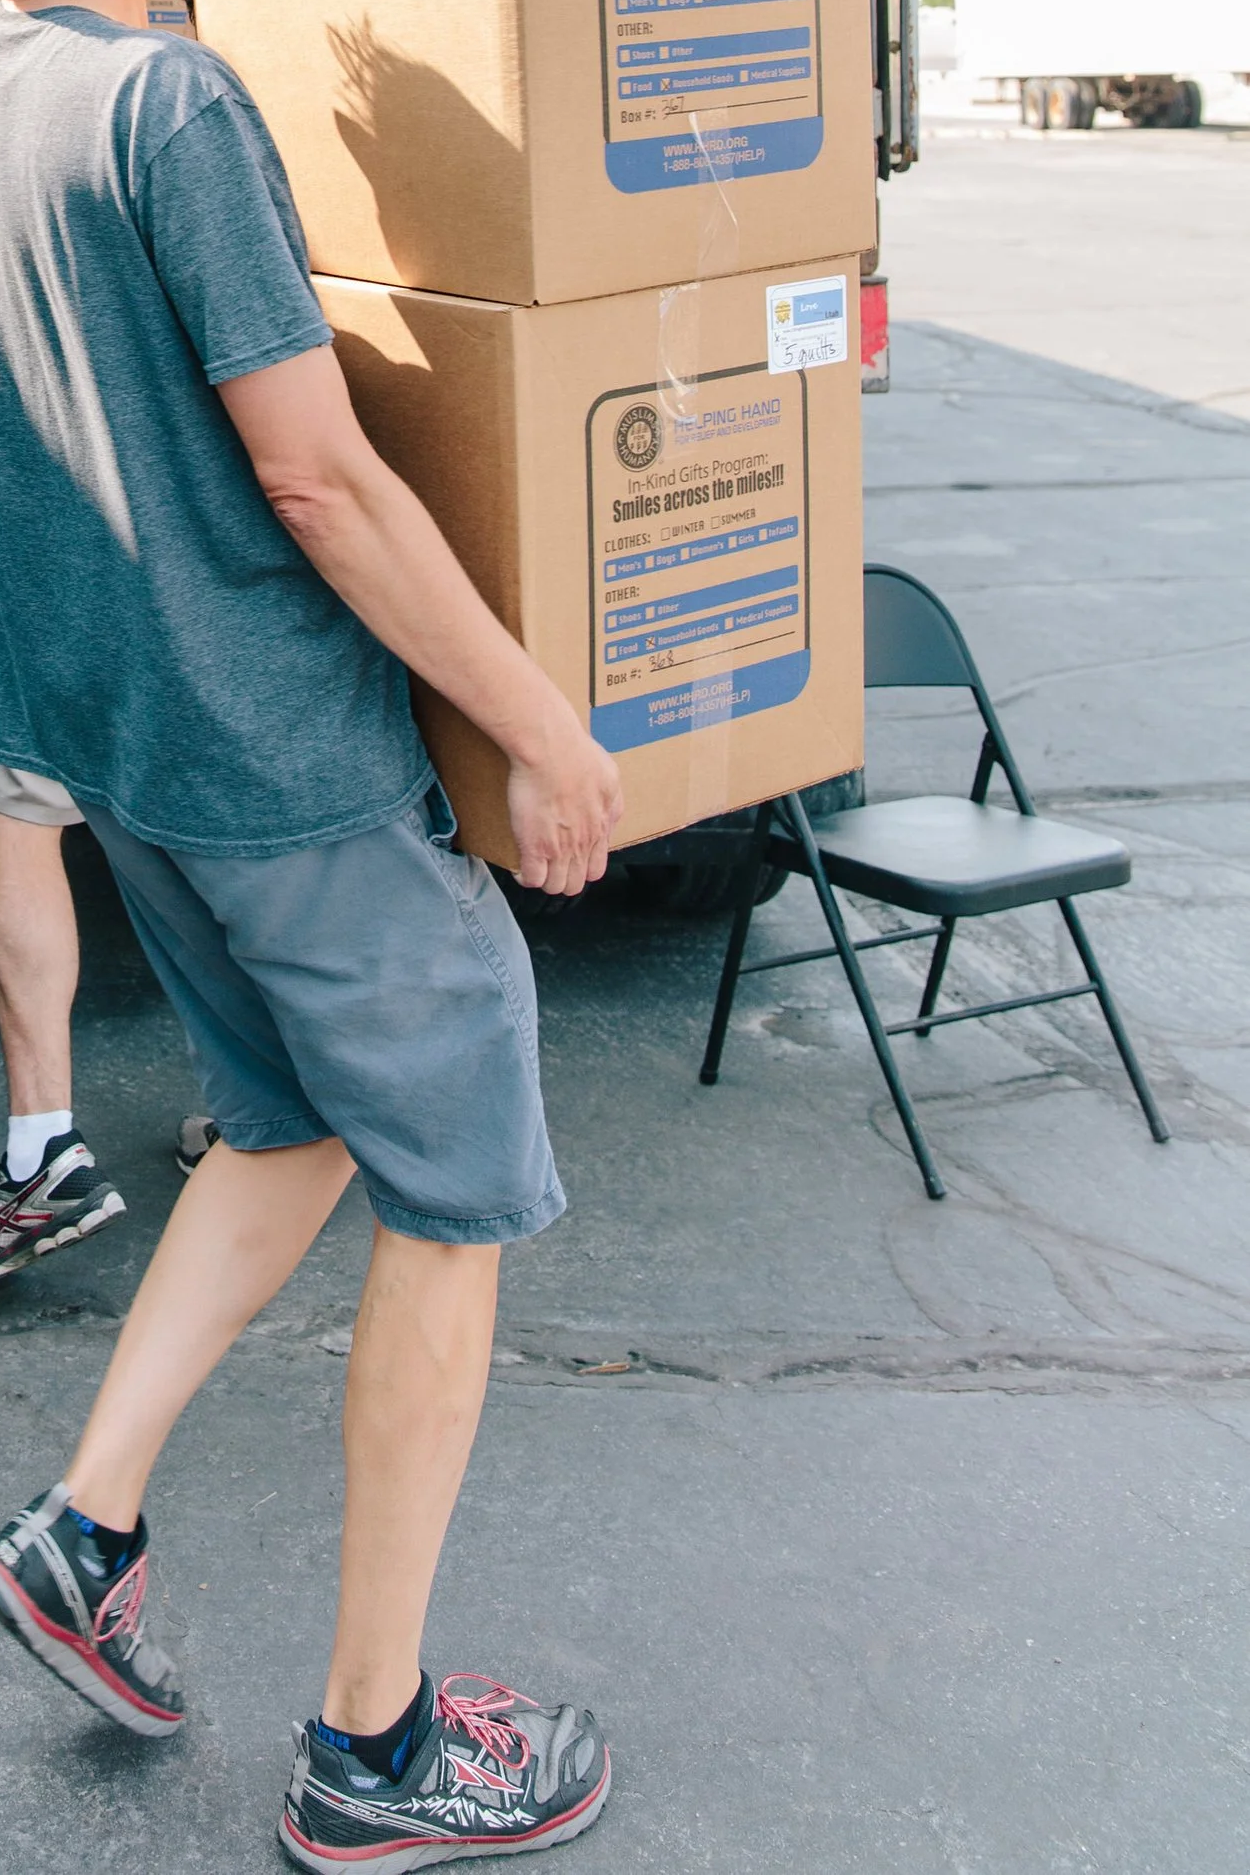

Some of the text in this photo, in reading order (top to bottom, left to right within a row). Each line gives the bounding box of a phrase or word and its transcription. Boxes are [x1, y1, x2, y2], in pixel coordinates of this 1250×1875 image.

[617, 22, 654, 37] OTHER:
[632, 82, 653, 92] Food
[620, 110, 642, 123] Box
[799, 302, 819, 313] Love
[783, 343, 797, 365] 5
[674, 398, 781, 433] HELPING HAND
[716, 426, 732, 437] AND
[733, 415, 781, 434] DEVELOPMENT
[618, 442, 661, 467] HUMANITY
[628, 453, 769, 494] In-Kind Gifts Program:
[613, 464, 784, 523] Smiles across the miles!!!
[604, 508, 756, 553] CLOTHES: WINTER SUMMER
[618, 562, 642, 574] Men's
[656, 553, 677, 566] Boys
[769, 524, 794, 538] Infants
[605, 586, 640, 604] OTHER:
[619, 613, 642, 624] Shoes
[619, 643, 639, 656] Food
[736, 610, 763, 625] Medical
[764, 603, 793, 618] Supplies
[606, 673, 628, 687] Box
[648, 680, 734, 713] WWW.HHRD.ORG
[341, 1802, 378, 1818] ALTRA
